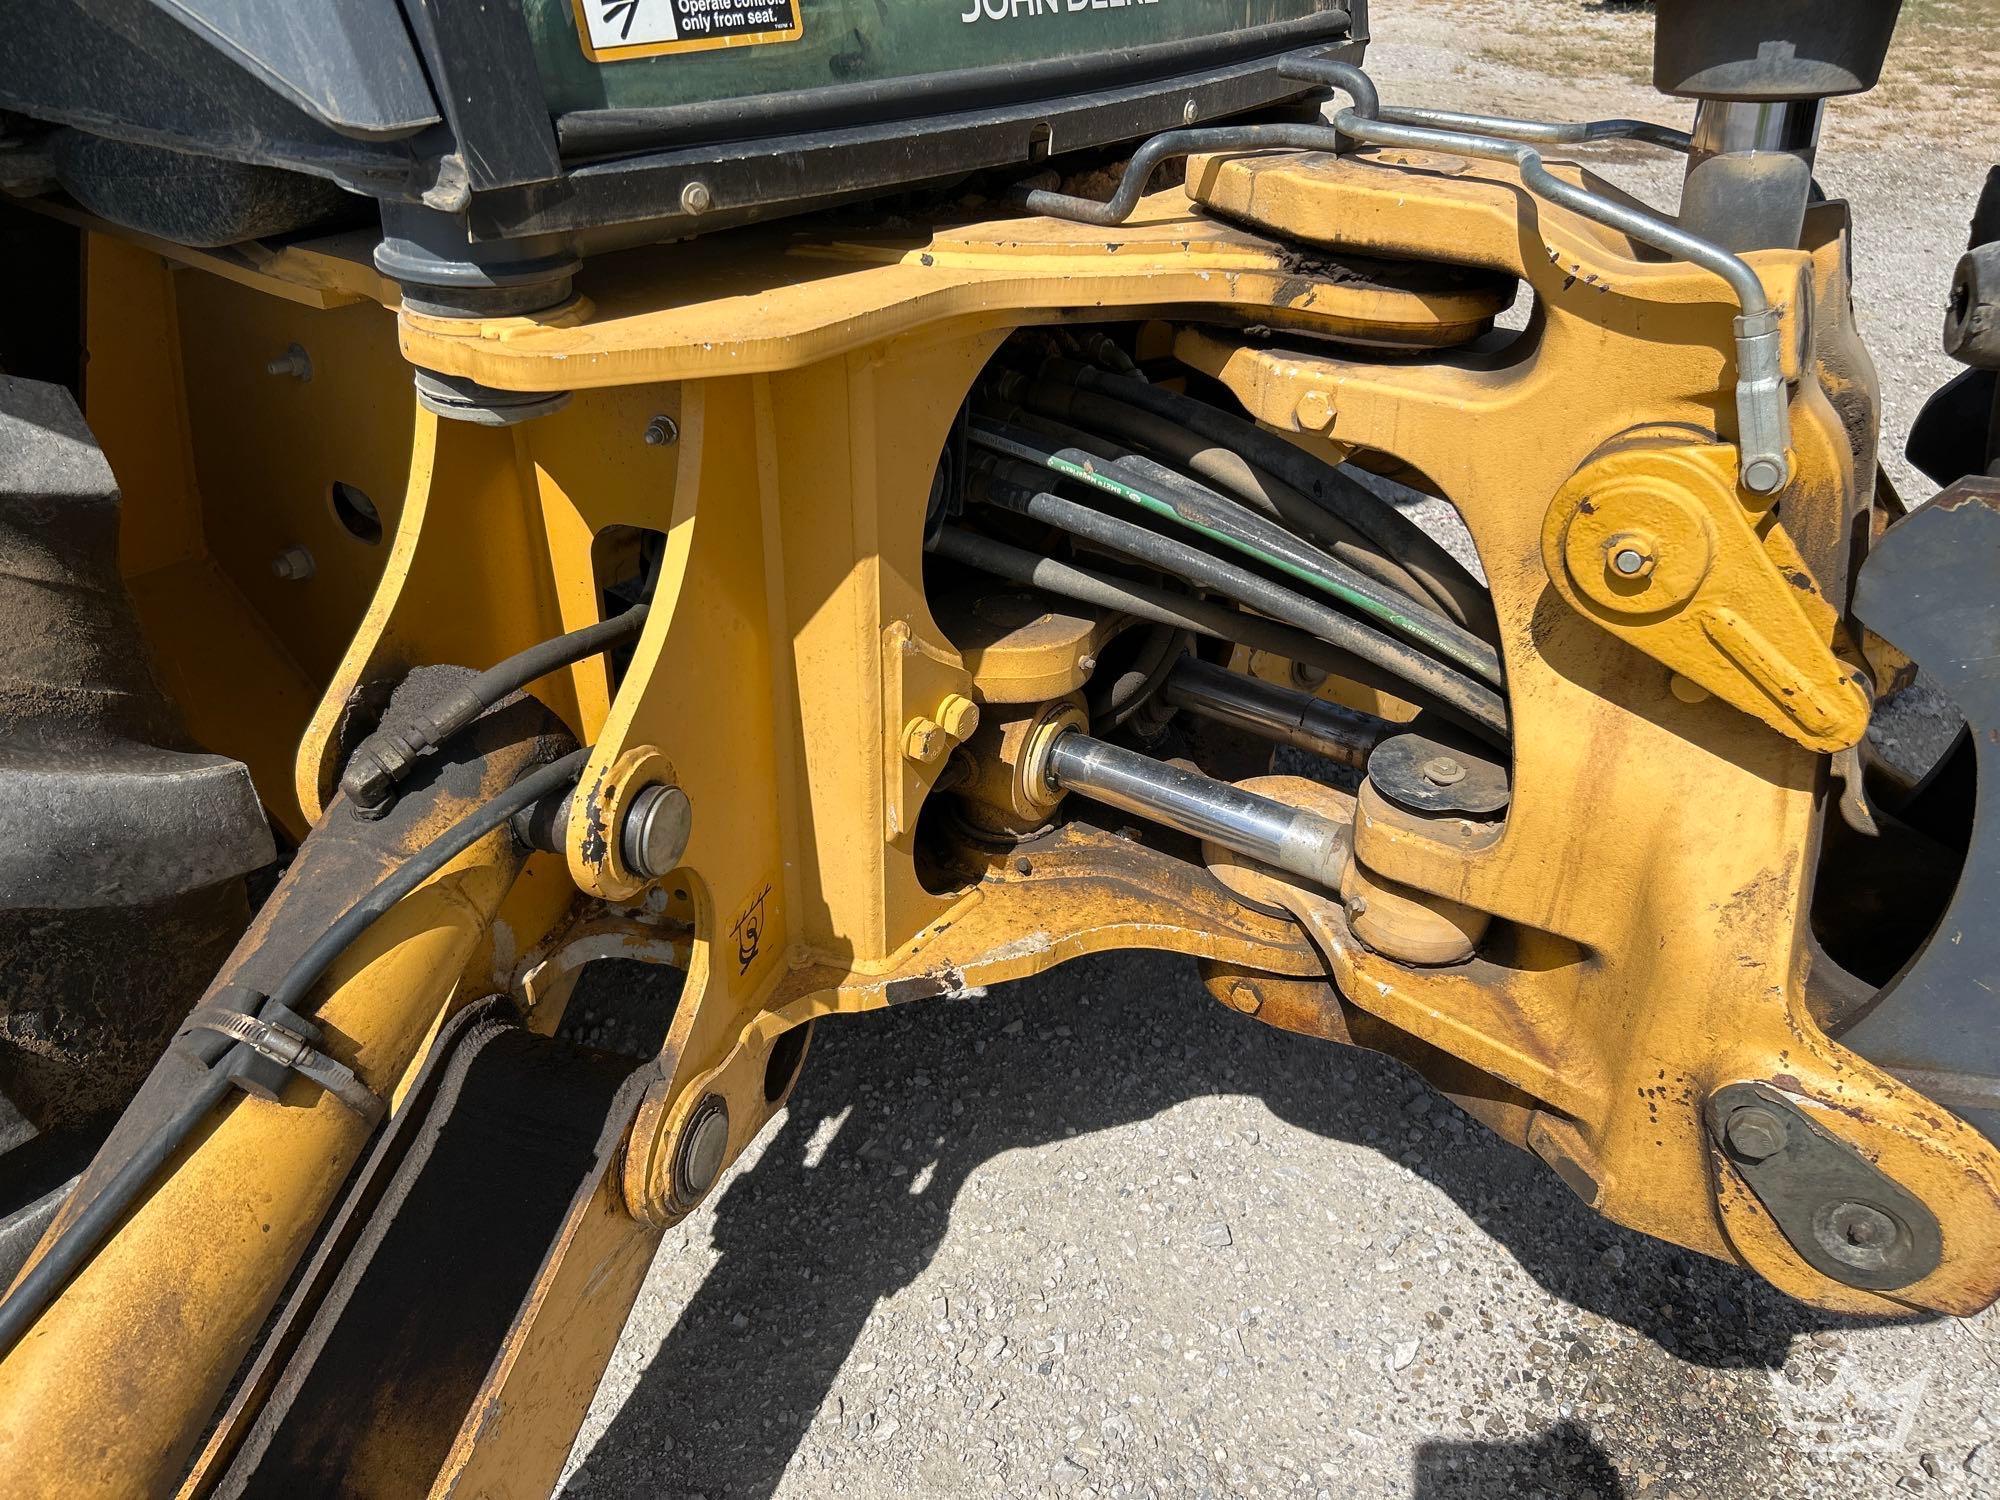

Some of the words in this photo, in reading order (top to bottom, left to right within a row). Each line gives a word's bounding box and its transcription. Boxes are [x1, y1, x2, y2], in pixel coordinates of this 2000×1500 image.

[678, 0, 732, 16] Operate
[681, 13, 711, 33] only
[713, 11, 745, 28] from
[747, 8, 778, 25] seat.
